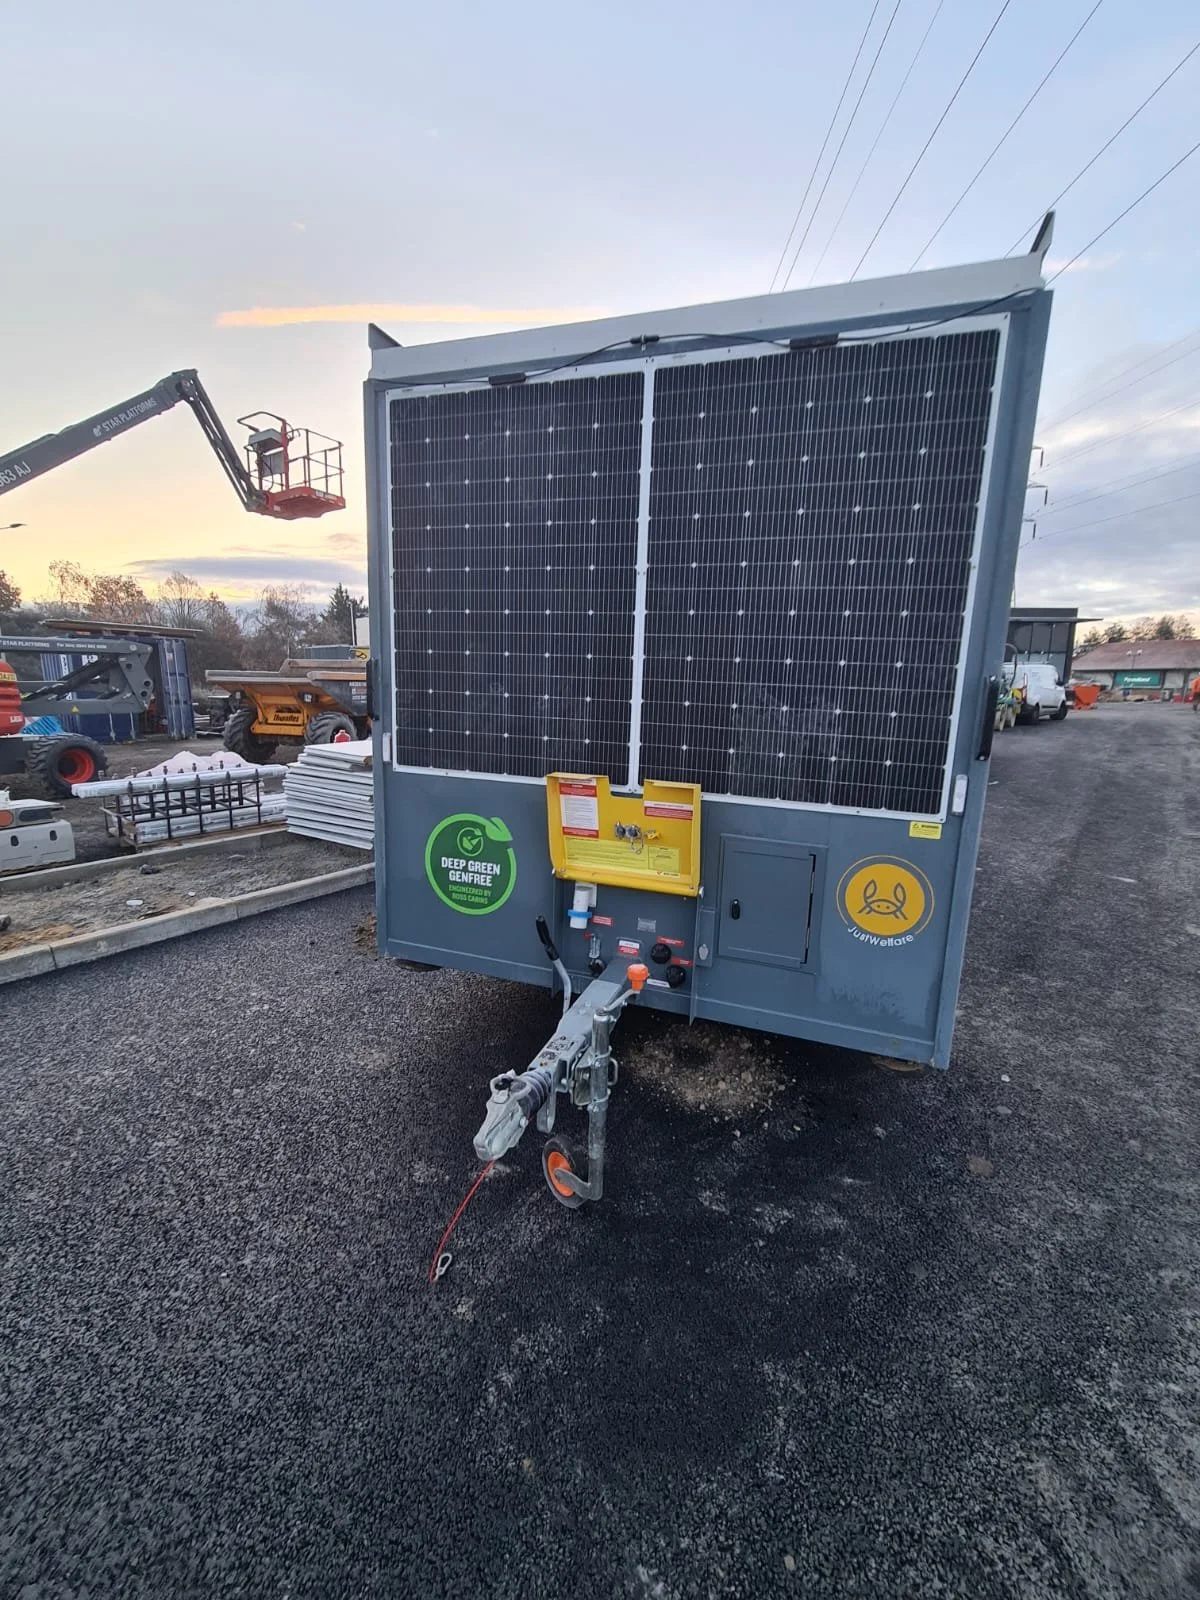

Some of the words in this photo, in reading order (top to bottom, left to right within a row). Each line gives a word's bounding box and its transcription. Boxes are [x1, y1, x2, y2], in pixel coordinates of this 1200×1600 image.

[102, 416, 122, 432] STAR
[119, 397, 157, 422] PLATFORMS
[14, 460, 32, 478] AJ
[441, 857, 466, 869] DEEP
[468, 861, 500, 875] GREEN
[449, 870, 492, 886] GENFREE
[449, 885, 483, 895] ENGINEERED
[484, 889, 491, 897] BY
[847, 925, 914, 947] JustWelfare
